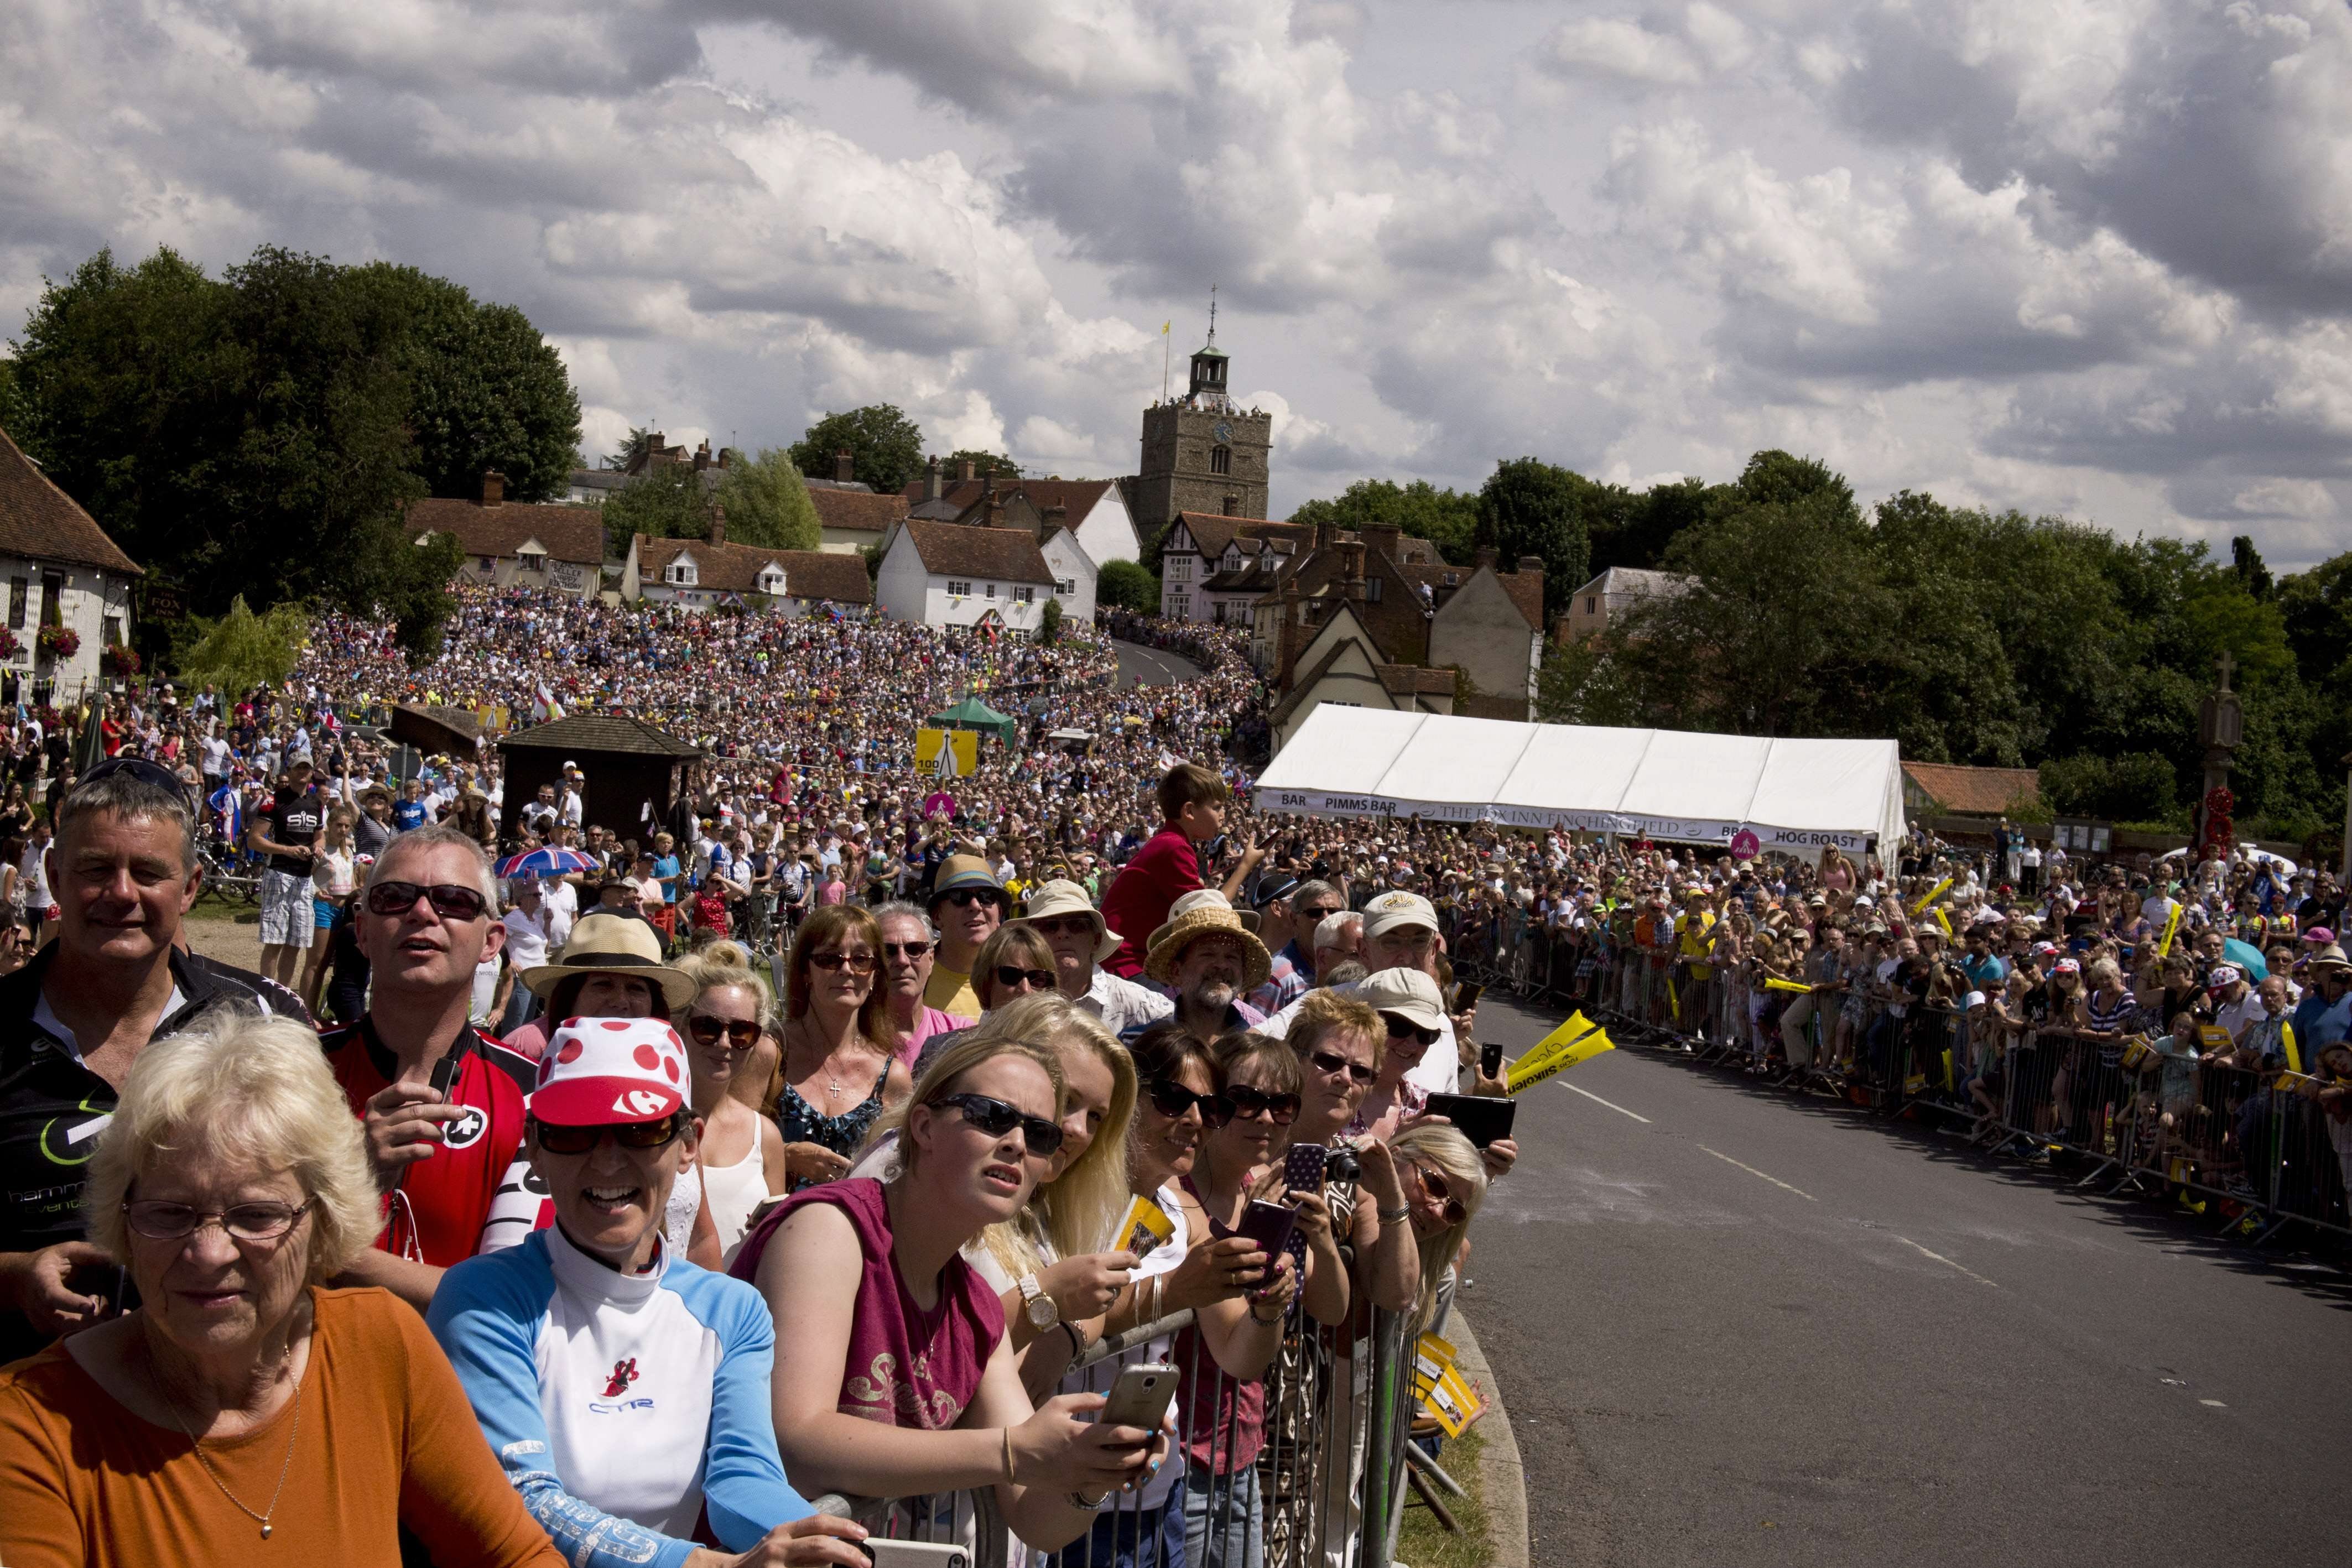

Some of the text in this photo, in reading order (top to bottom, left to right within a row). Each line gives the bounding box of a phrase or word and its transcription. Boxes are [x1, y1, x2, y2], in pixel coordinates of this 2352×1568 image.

[152, 597, 181, 610] FOX
[918, 760, 939, 768] 100
[1282, 794, 1306, 806] BAR
[1325, 798, 1397, 813] PIMMS BAR
[1440, 806, 1679, 834] THE FOX INN FINCHINGFIELD
[1776, 831, 1859, 848] HOG ROAST
[1508, 1056, 1579, 1095] FUCHS Silkolen
[8, 1180, 89, 1203] hamm
[25, 1198, 90, 1213] Events
